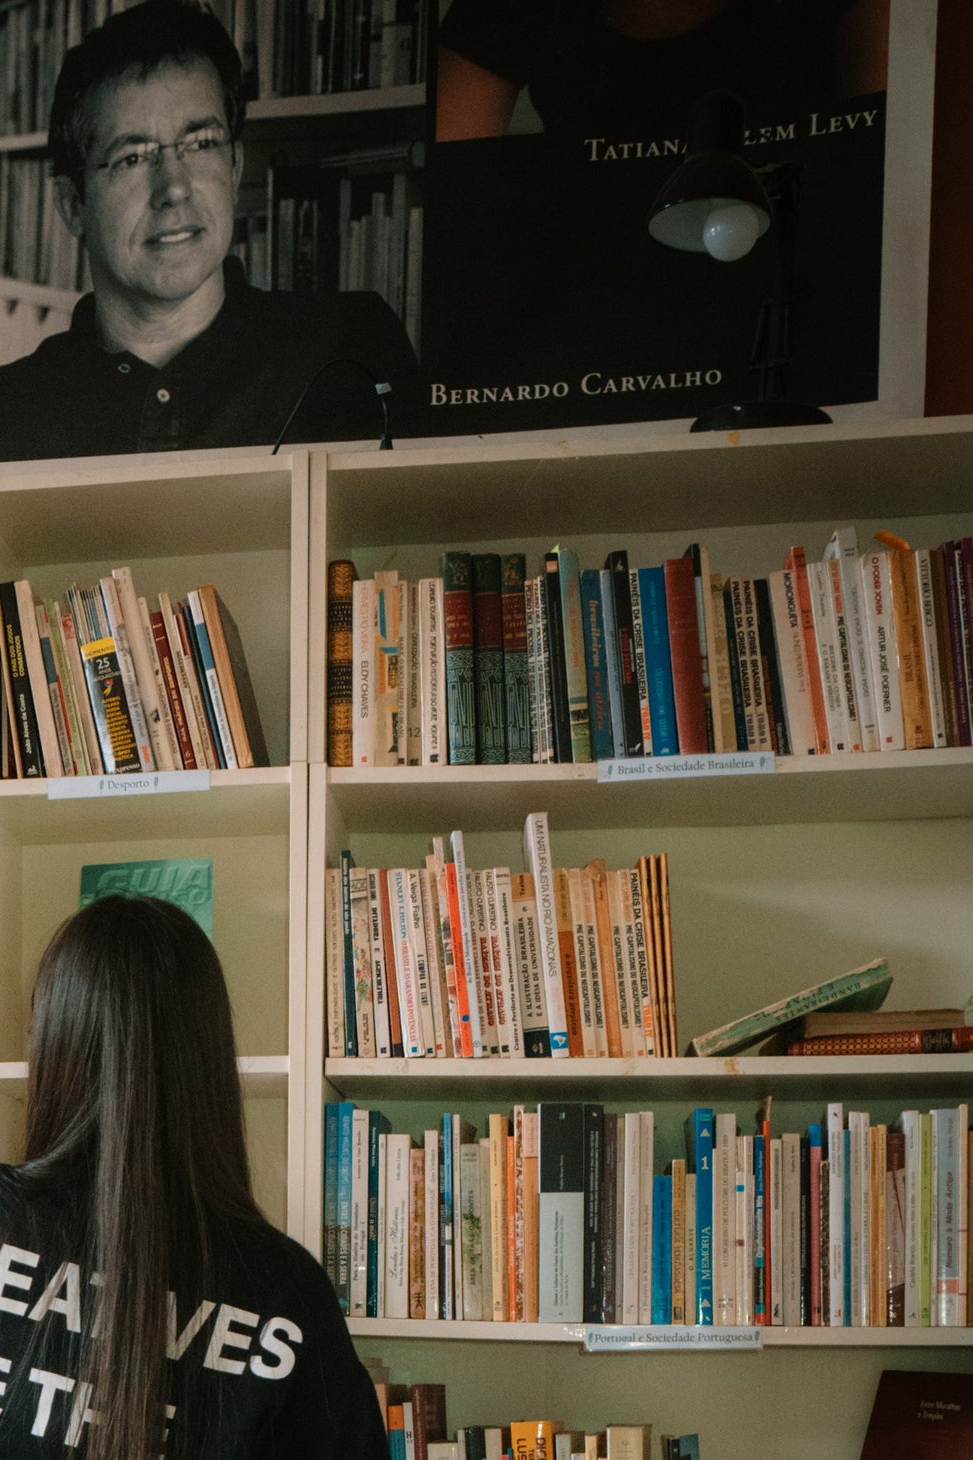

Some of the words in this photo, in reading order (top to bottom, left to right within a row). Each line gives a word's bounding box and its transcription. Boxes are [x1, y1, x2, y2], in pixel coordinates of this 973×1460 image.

[810, 109, 878, 137] LEVY
[429, 381, 569, 406] BERNARDO
[581, 368, 723, 396] CARVALHO
[876, 625, 887, 651] ARTUR
[96, 657, 110, 669] 25
[878, 652, 888, 671] JOSÉ
[360, 683, 368, 719] CHAVES
[880, 673, 891, 713] POERNER
[617, 765, 645, 775] Brasil
[656, 761, 705, 772] Sociedade
[708, 759, 755, 770] Brasileira
[107, 777, 150, 791] Desporto
[536, 835, 551, 892] NATURALISTA
[541, 893, 551, 906] NO
[543, 907, 553, 924] RIO
[544, 926, 557, 977] AMAZONAS
[700, 1156, 709, 1170] 1
[699, 1226, 711, 1280] MEMÓRIA
[594, 1333, 636, 1344] Portugal
[646, 1332, 697, 1343] Sociedade
[698, 1332, 753, 1344] Portuguesa
